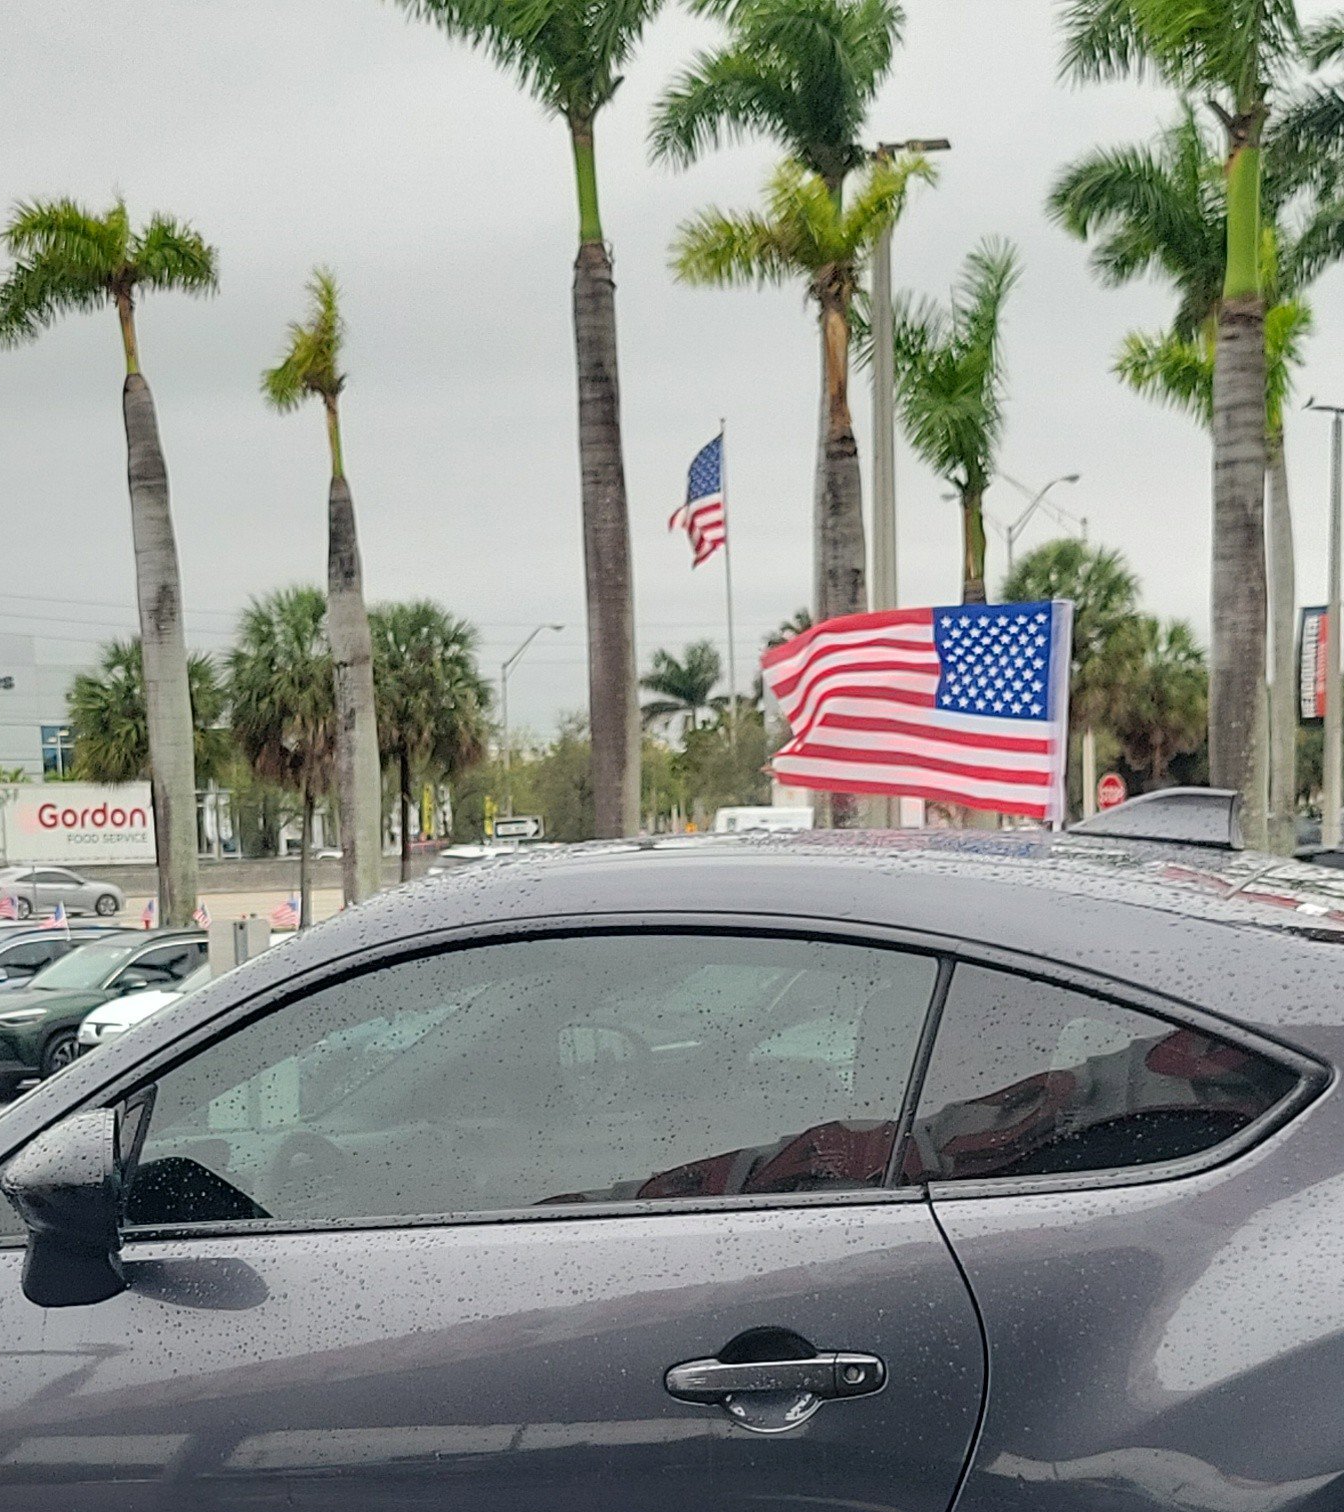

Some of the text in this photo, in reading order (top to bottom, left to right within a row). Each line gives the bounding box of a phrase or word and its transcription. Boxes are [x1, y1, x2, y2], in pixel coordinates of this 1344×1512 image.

[38, 802, 147, 829] Gordon
[67, 833, 148, 844] FOOD SERVICE
